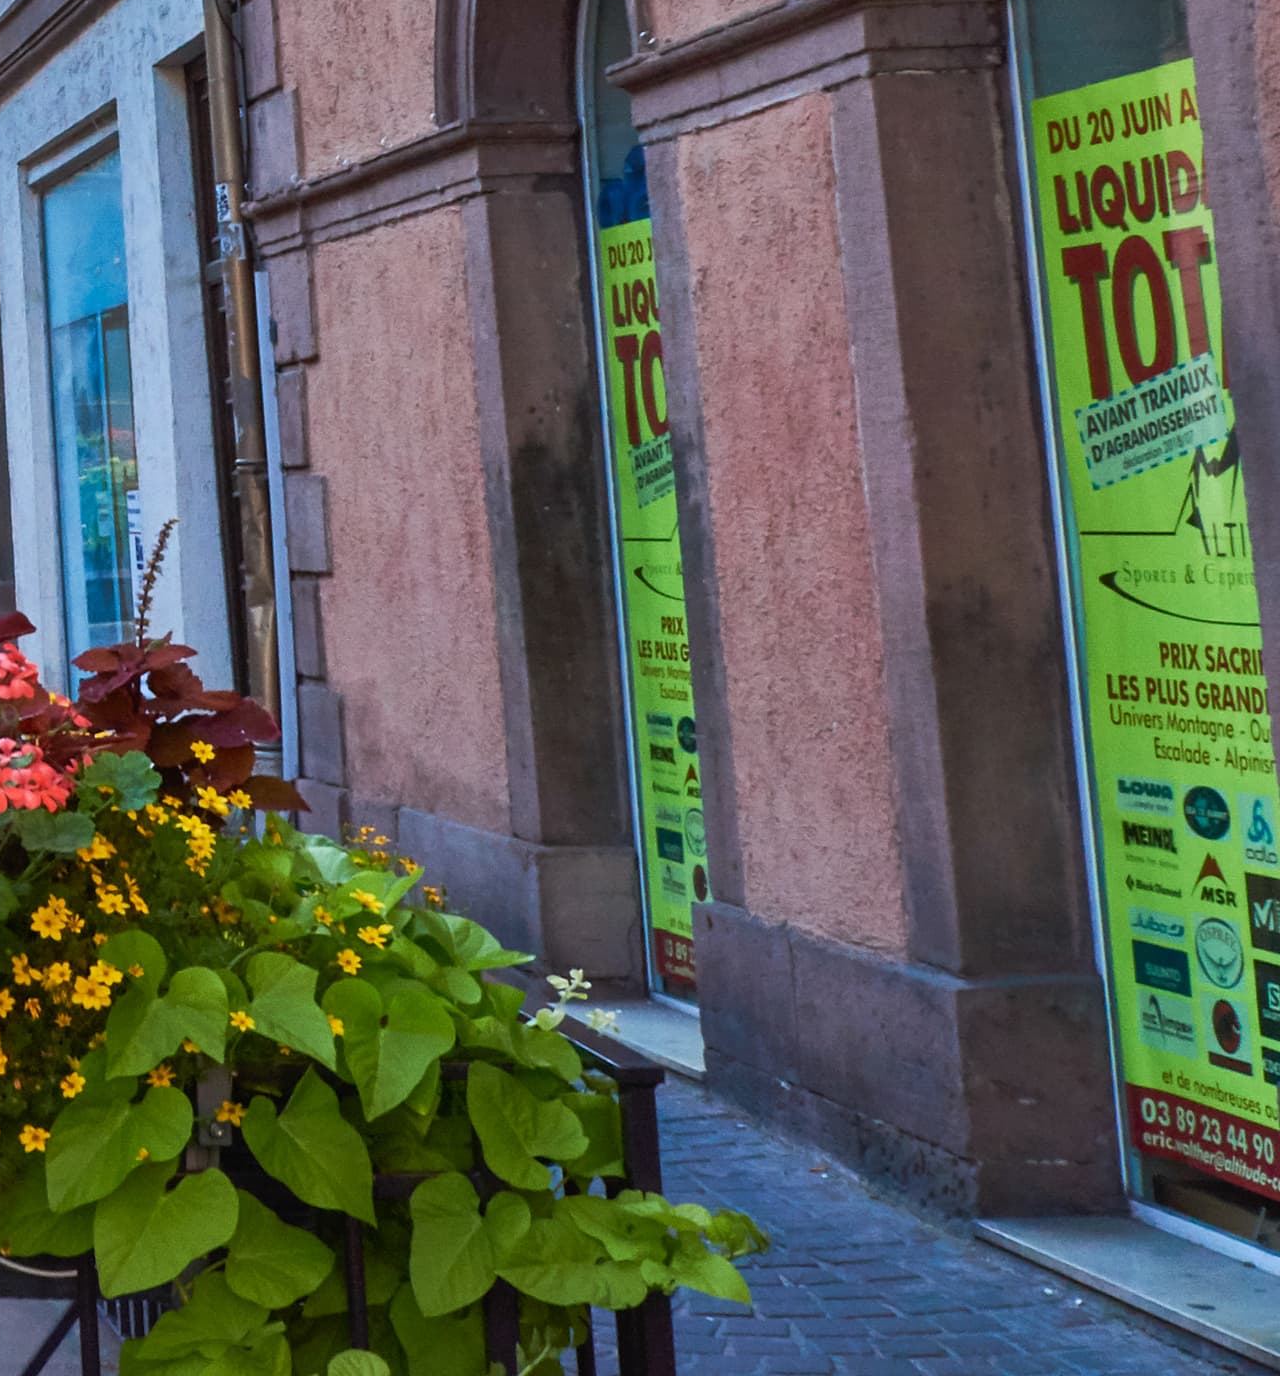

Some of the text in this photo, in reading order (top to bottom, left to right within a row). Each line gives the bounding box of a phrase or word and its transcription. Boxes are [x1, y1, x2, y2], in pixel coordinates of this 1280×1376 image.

[1047, 87, 1200, 154] DU 20 JUIN A
[1053, 150, 1209, 236] LIQUID
[608, 243, 627, 269] DU
[628, 239, 644, 265] 20
[1061, 225, 1231, 400] TOT
[1086, 364, 1213, 438] AVANT TRAVAUX
[1091, 395, 1218, 464] D'AGRANDISSEMENT
[634, 443, 663, 471] AVANT
[1184, 563, 1196, 585] &
[661, 616, 685, 636] PRIX
[637, 640, 653, 659] LES
[655, 640, 679, 662] PLUS
[1159, 641, 1201, 671] PRIX
[1106, 674, 1271, 716] LES PLUS GRAND
[1109, 703, 1163, 731] Univers
[1167, 710, 1235, 743] Montagne
[1153, 737, 1211, 766] Escalade
[1117, 778, 1174, 801] LOWA
[1200, 885, 1239, 909] MSR
[1162, 1069, 1173, 1085] et
[1177, 1070, 1191, 1091] de
[1194, 1080, 1261, 1115] nombreuses
[1141, 1097, 1274, 1165] 03 89 23 44 90
